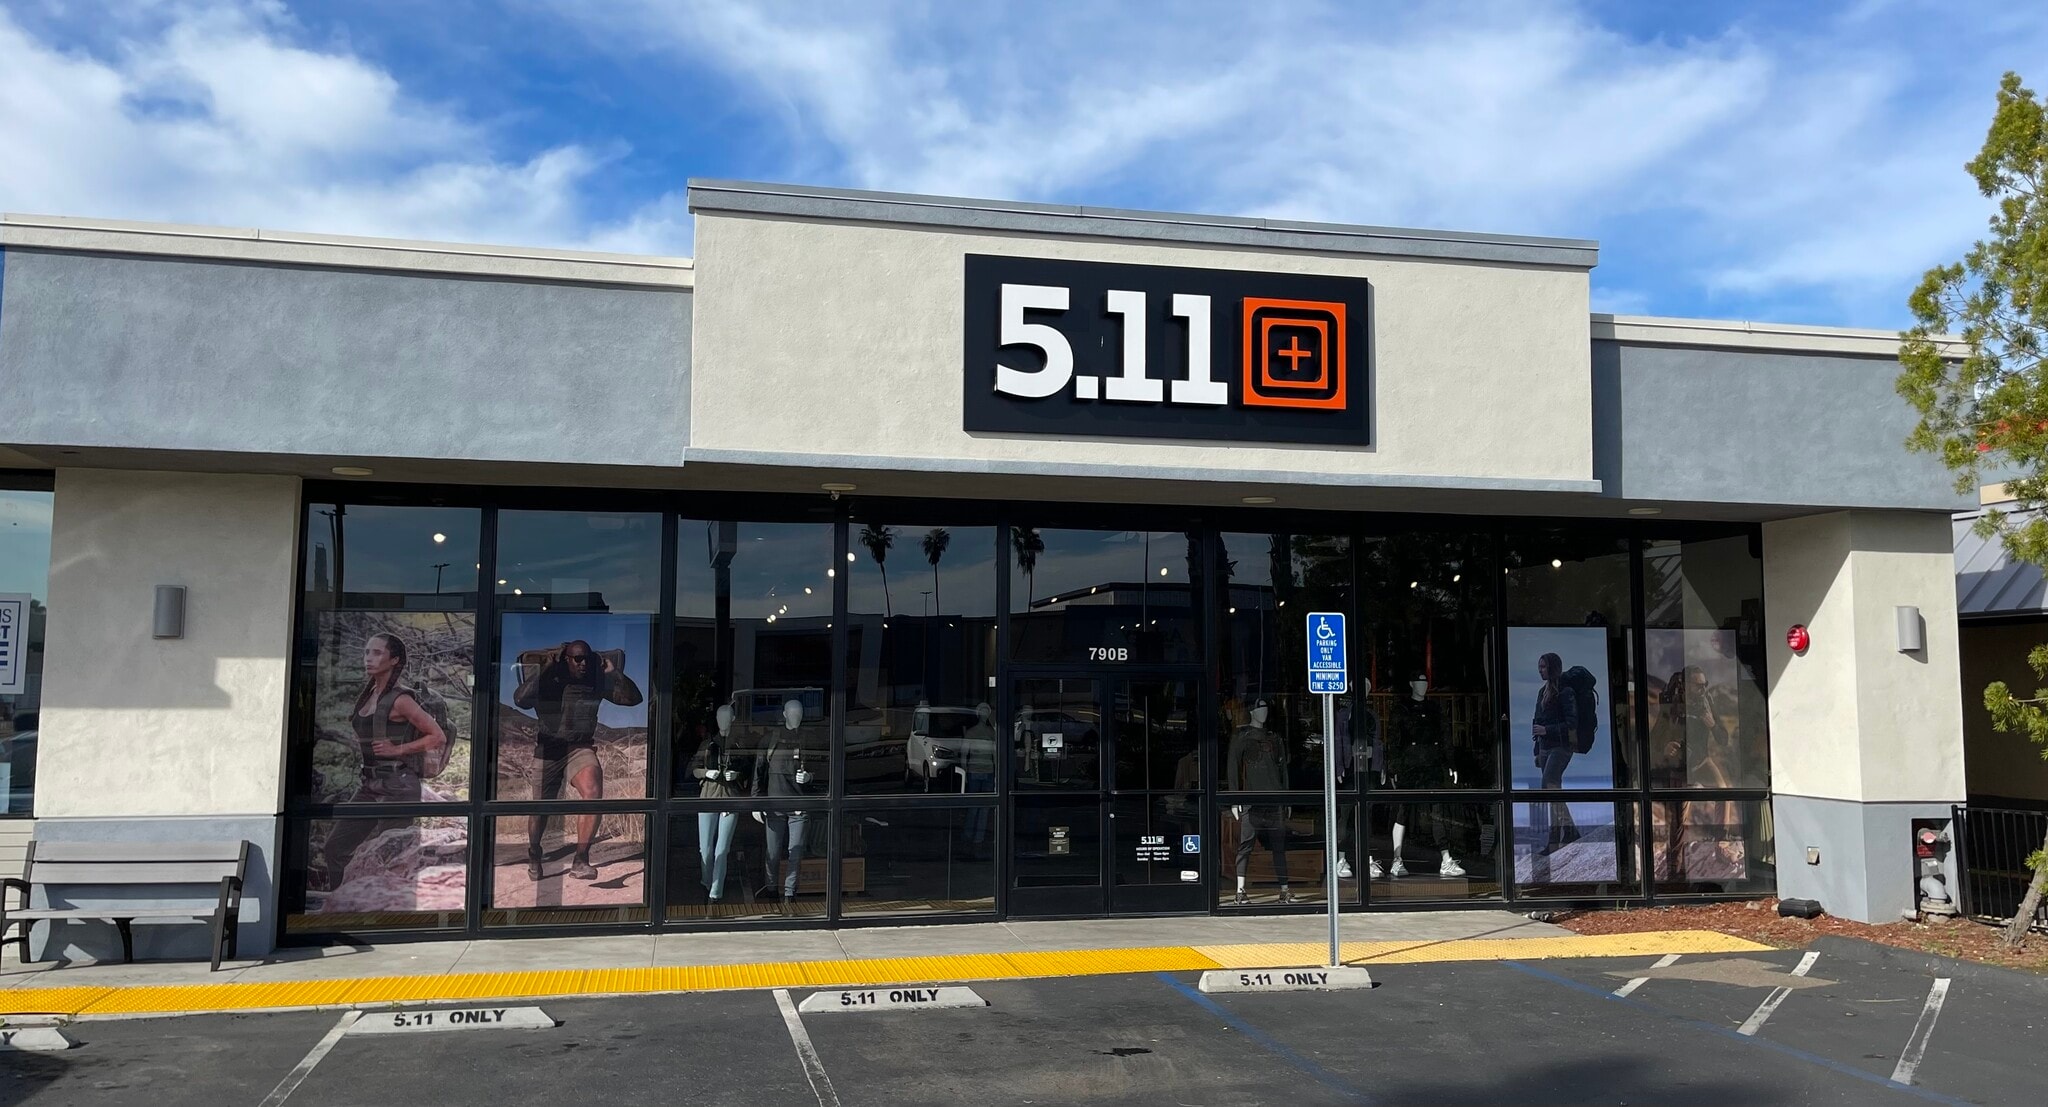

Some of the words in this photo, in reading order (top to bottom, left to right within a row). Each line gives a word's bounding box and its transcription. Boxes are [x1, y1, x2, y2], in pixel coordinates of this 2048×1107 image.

[996, 283, 1229, 404] 5.11
[0, 608, 12, 623] S
[1089, 647, 1128, 661] 790B
[1313, 661, 1342, 669] ACCESSIBLE
[1315, 672, 1340, 681] MINIMUM
[1312, 681, 1324, 690] FINE
[1328, 681, 1344, 690] $250
[1240, 974, 1272, 986] 5.11
[1284, 973, 1328, 985] ONLY
[841, 992, 876, 1006] 5.11
[889, 989, 939, 1003] ONLY
[393, 1013, 433, 1027] 5.11
[449, 1010, 506, 1024] ONLY
